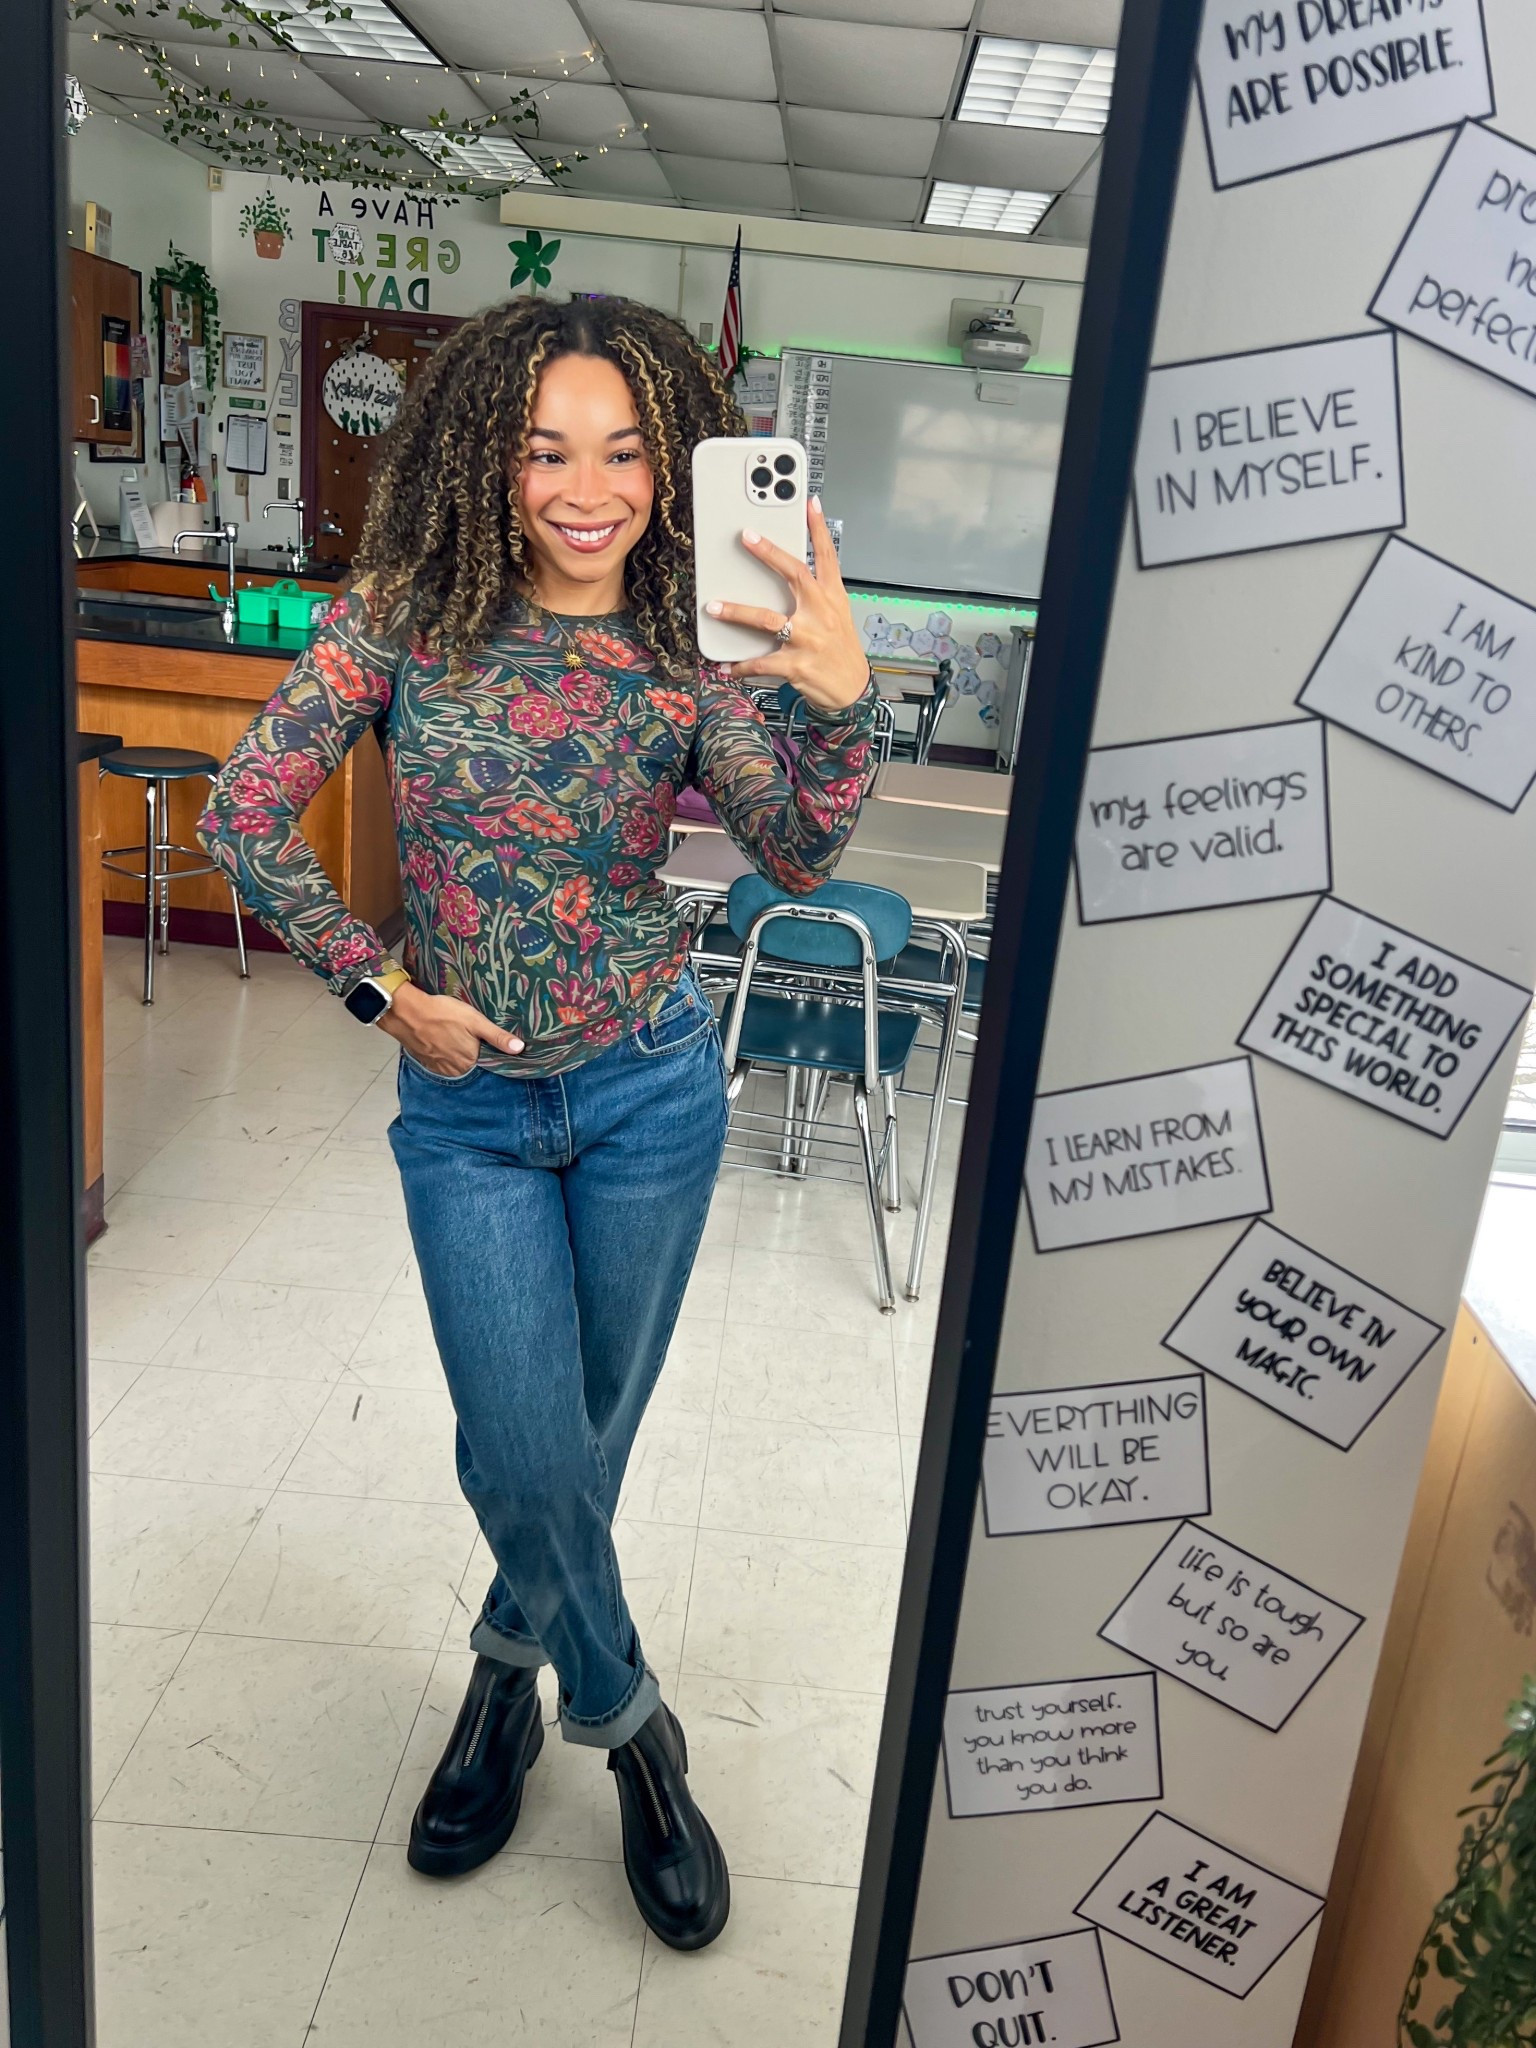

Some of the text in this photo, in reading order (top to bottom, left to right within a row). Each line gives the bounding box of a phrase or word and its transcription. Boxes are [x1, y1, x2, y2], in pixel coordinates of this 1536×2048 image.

[1228, 28, 1464, 128] ARE POSSIBLE.
[1173, 389, 1358, 454] I BELIEVE
[1155, 443, 1384, 514] IN MYSELF.
[1443, 602, 1516, 662] I AM
[1394, 635, 1513, 715] KIND TO
[1375, 684, 1481, 757] OTHERS.
[1090, 770, 1307, 831] my feelings
[1121, 818, 1284, 871] are valid.
[1371, 942, 1459, 998] I ADD
[1310, 953, 1481, 1050] SOMETHING
[1295, 986, 1460, 1079] SPECIAL TO
[1270, 1012, 1443, 1114] THIS WORLD.
[1045, 1109, 1232, 1166] I LEARN FROM
[1049, 1147, 1242, 1205] MY MISTAKES.
[1263, 1258, 1396, 1349] BELIEVE IN
[1235, 1337, 1319, 1400] MAGIC.
[1307, 1335, 1378, 1383] OWN
[985, 1391, 1198, 1438] EVERYTHING
[1026, 1435, 1160, 1473] WILL BE
[1047, 1475, 1149, 1510] OKAY.
[1177, 1545, 1325, 1642] life is tough
[1167, 1582, 1291, 1666] but so are
[963, 1719, 1137, 1753] you know more
[975, 1692, 1122, 1723] trust yourself.
[976, 1746, 1128, 1775] than you think
[1017, 1776, 1093, 1800] you do.
[1147, 1876, 1257, 1940] A GREAT
[1184, 1861, 1258, 1910] I AM
[1117, 1889, 1237, 1967] LISTENER.
[972, 2011, 1057, 2048] QUIT.
